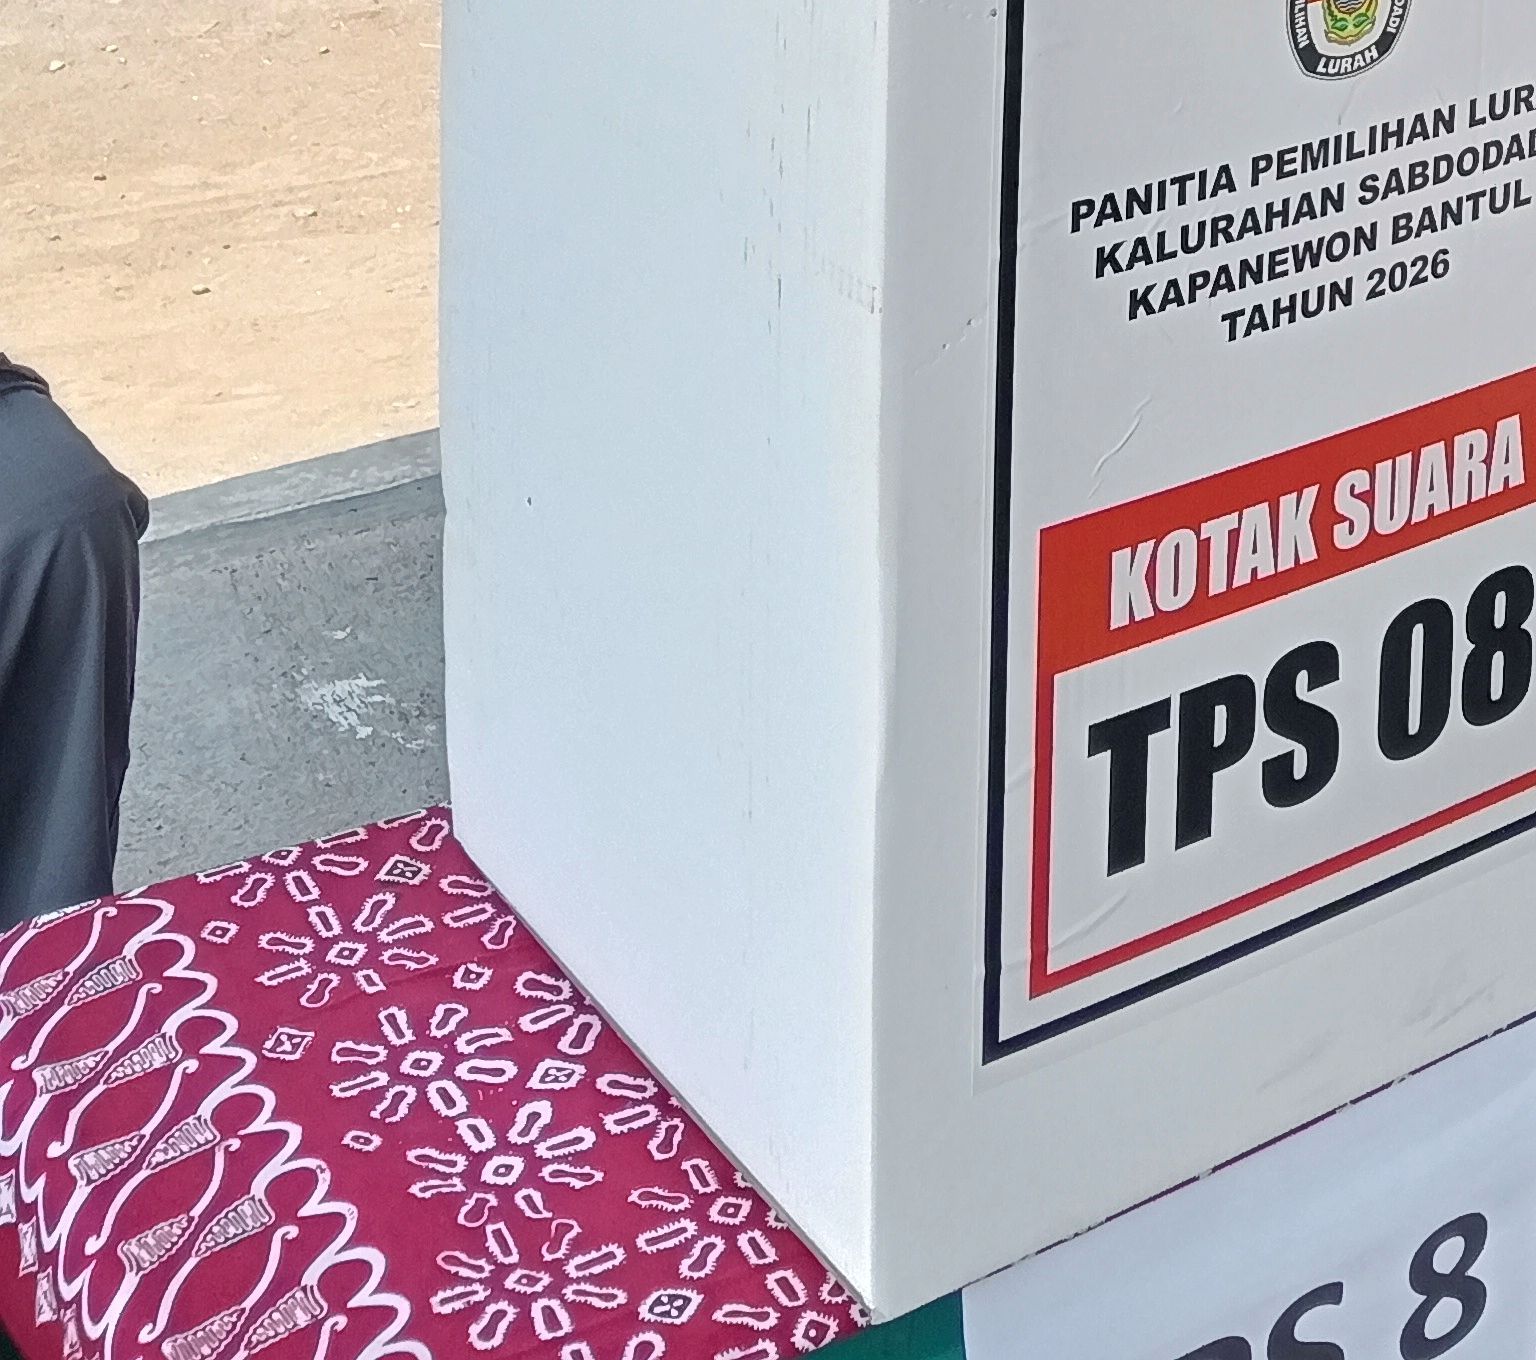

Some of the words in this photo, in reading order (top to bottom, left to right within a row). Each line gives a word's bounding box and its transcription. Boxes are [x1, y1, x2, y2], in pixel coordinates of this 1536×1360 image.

[1315, 44, 1379, 74] LURAH
[1070, 163, 1237, 234] PANITIA
[1250, 103, 1456, 187] PEMILIHAN
[1095, 182, 1346, 279] KALURAHAN
[1127, 223, 1378, 321] KAPANEWON
[1391, 178, 1532, 245] BANTUL
[1220, 276, 1353, 343] TAHUN
[1365, 248, 1451, 301] 2026
[1108, 484, 1320, 632] KOTAK
[1332, 413, 1526, 551] SUARA
[1087, 640, 1341, 877] TPS
[1377, 565, 1535, 762] 08
[1400, 1212, 1488, 1360] 8
